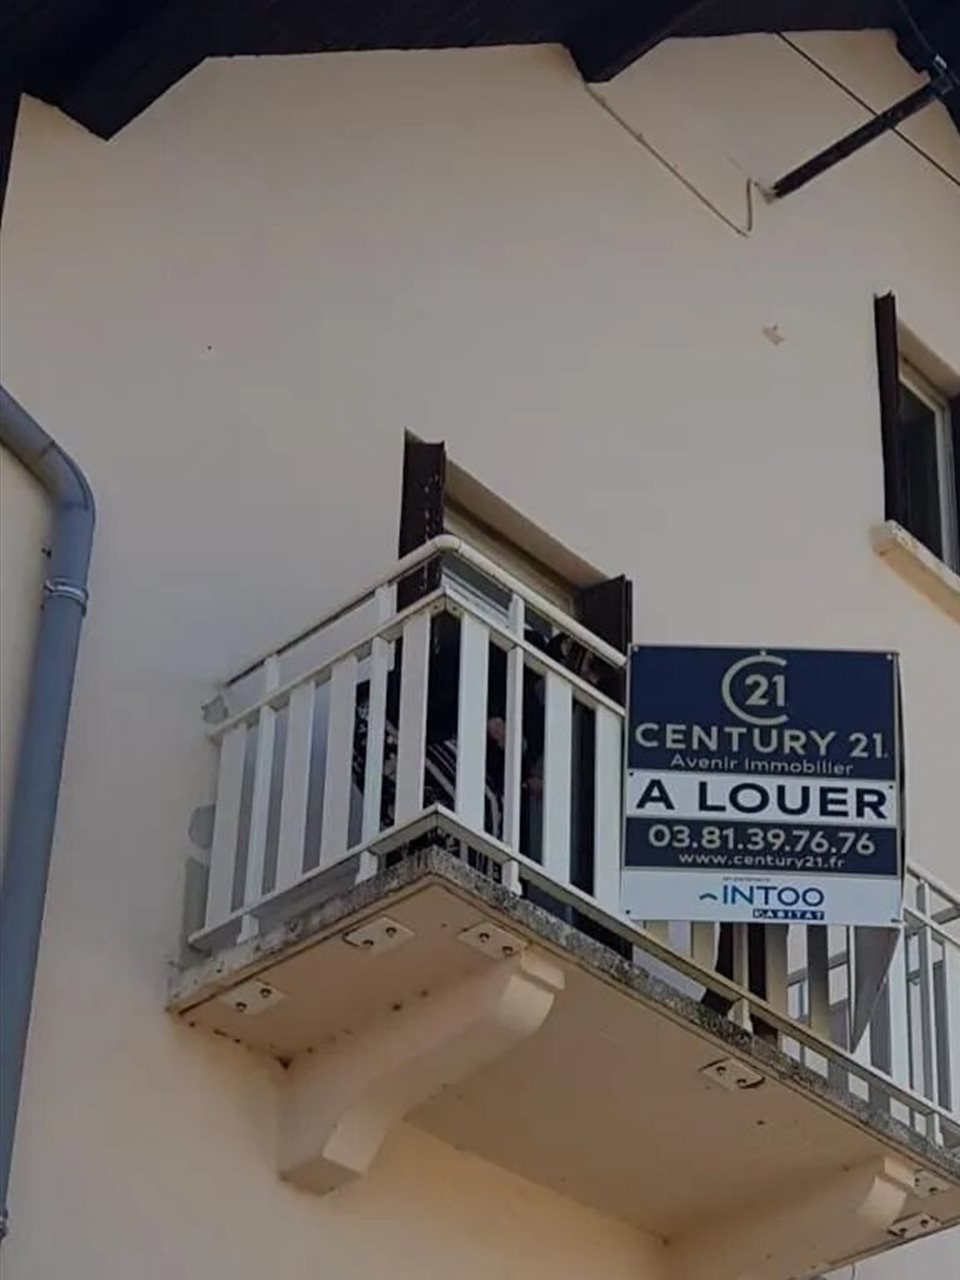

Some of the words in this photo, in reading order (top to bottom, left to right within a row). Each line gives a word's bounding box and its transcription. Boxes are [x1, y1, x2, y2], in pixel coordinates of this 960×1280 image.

[634, 722, 837, 756] CENTURY
[849, 732, 884, 759] 21
[670, 754, 737, 771] Avenir
[745, 755, 854, 776] Immobilier
[635, 779, 675, 810] A
[698, 781, 888, 820] LOUER
[648, 824, 876, 856] 03.81.39.76.76
[678, 851, 845, 870] www.century21.fr
[722, 884, 825, 907] INTOO
